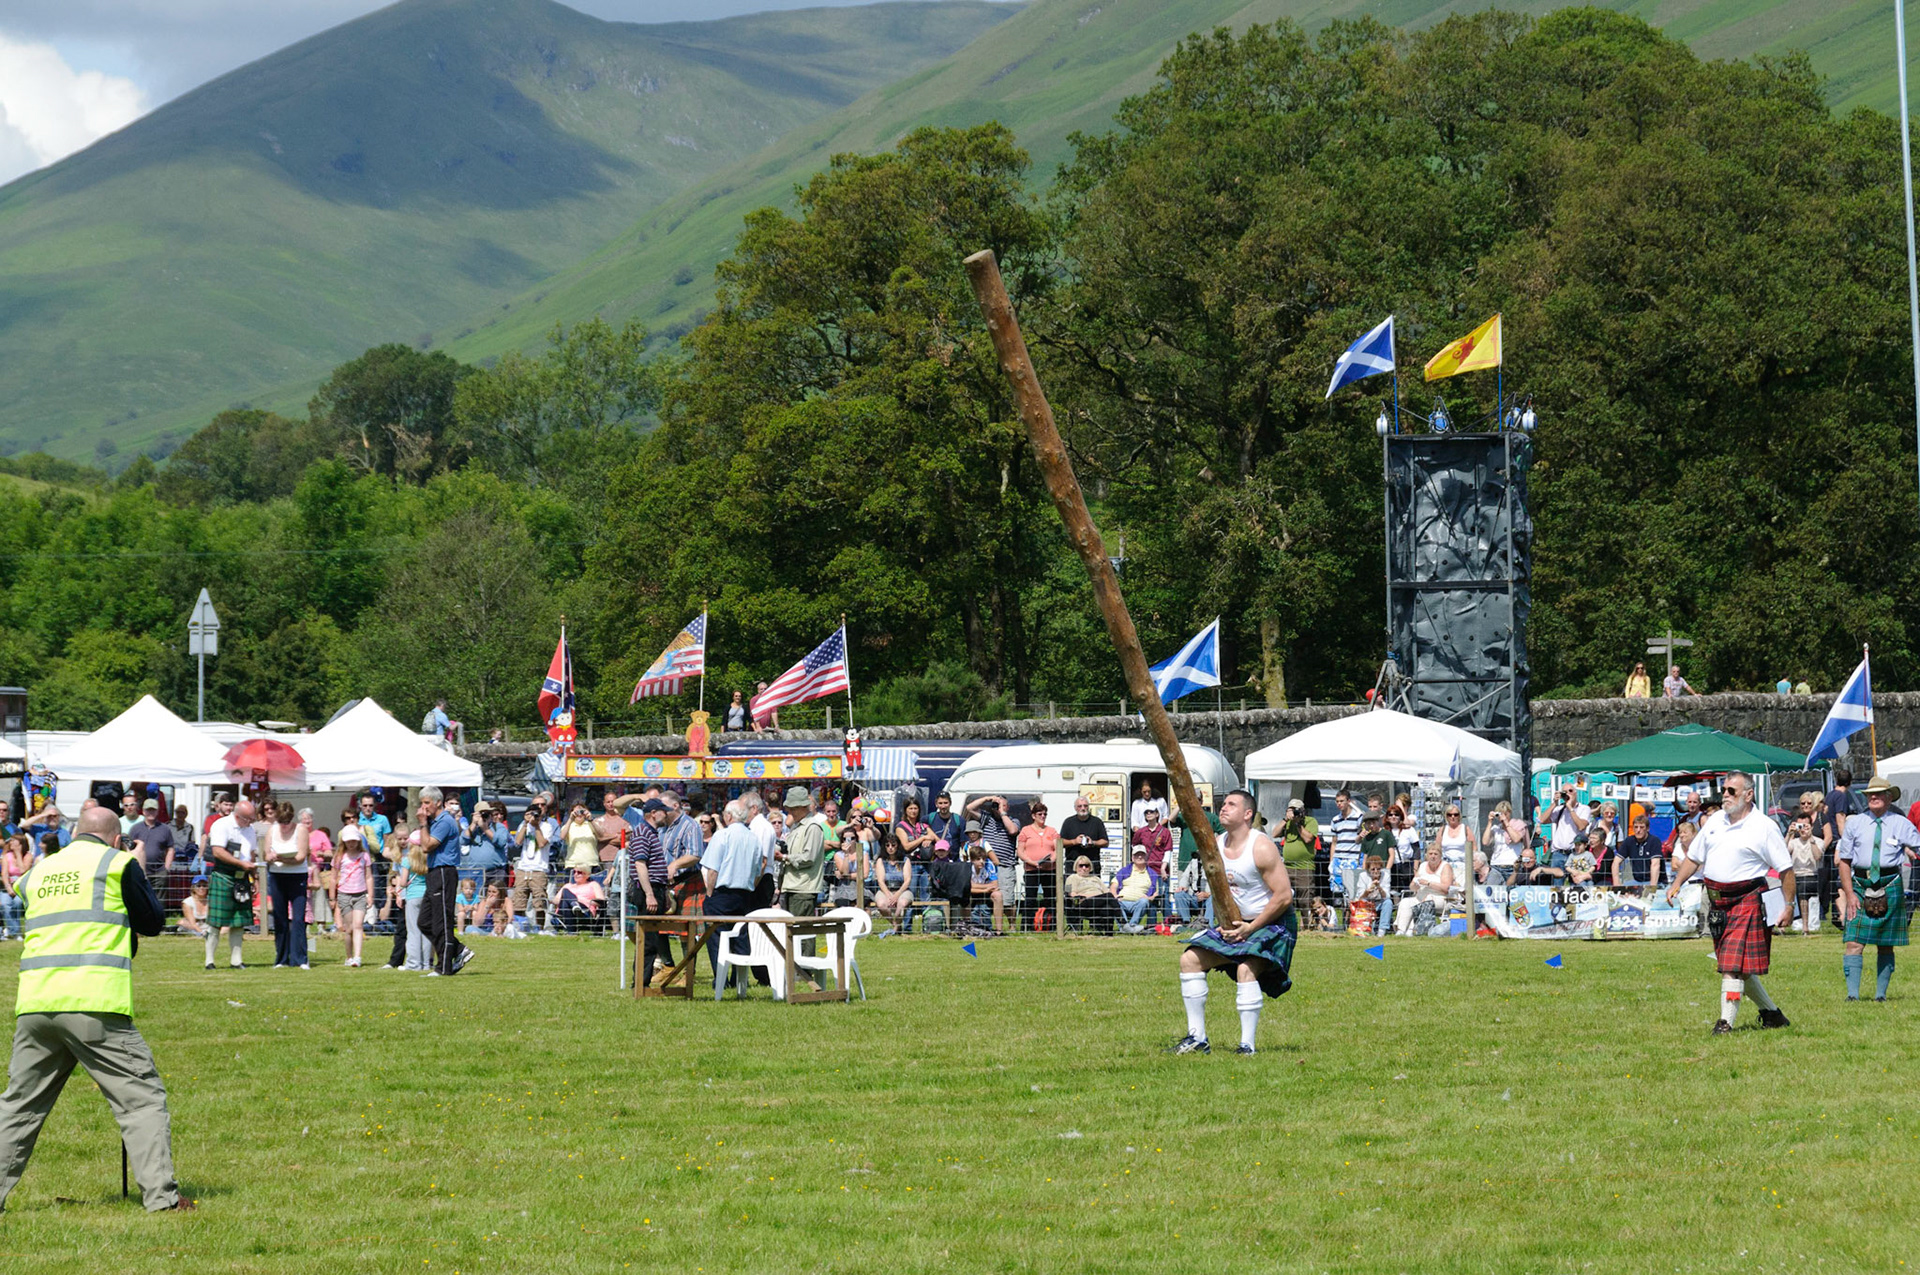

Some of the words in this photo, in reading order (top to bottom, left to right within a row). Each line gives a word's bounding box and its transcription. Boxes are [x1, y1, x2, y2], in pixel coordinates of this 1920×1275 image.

[42, 871, 80, 885] PRESS
[37, 883, 80, 898] OFFICE
[1493, 887, 1518, 902] the
[1525, 887, 1558, 906] sign
[1563, 887, 1621, 906] factory
[1596, 915, 1641, 928] 01324
